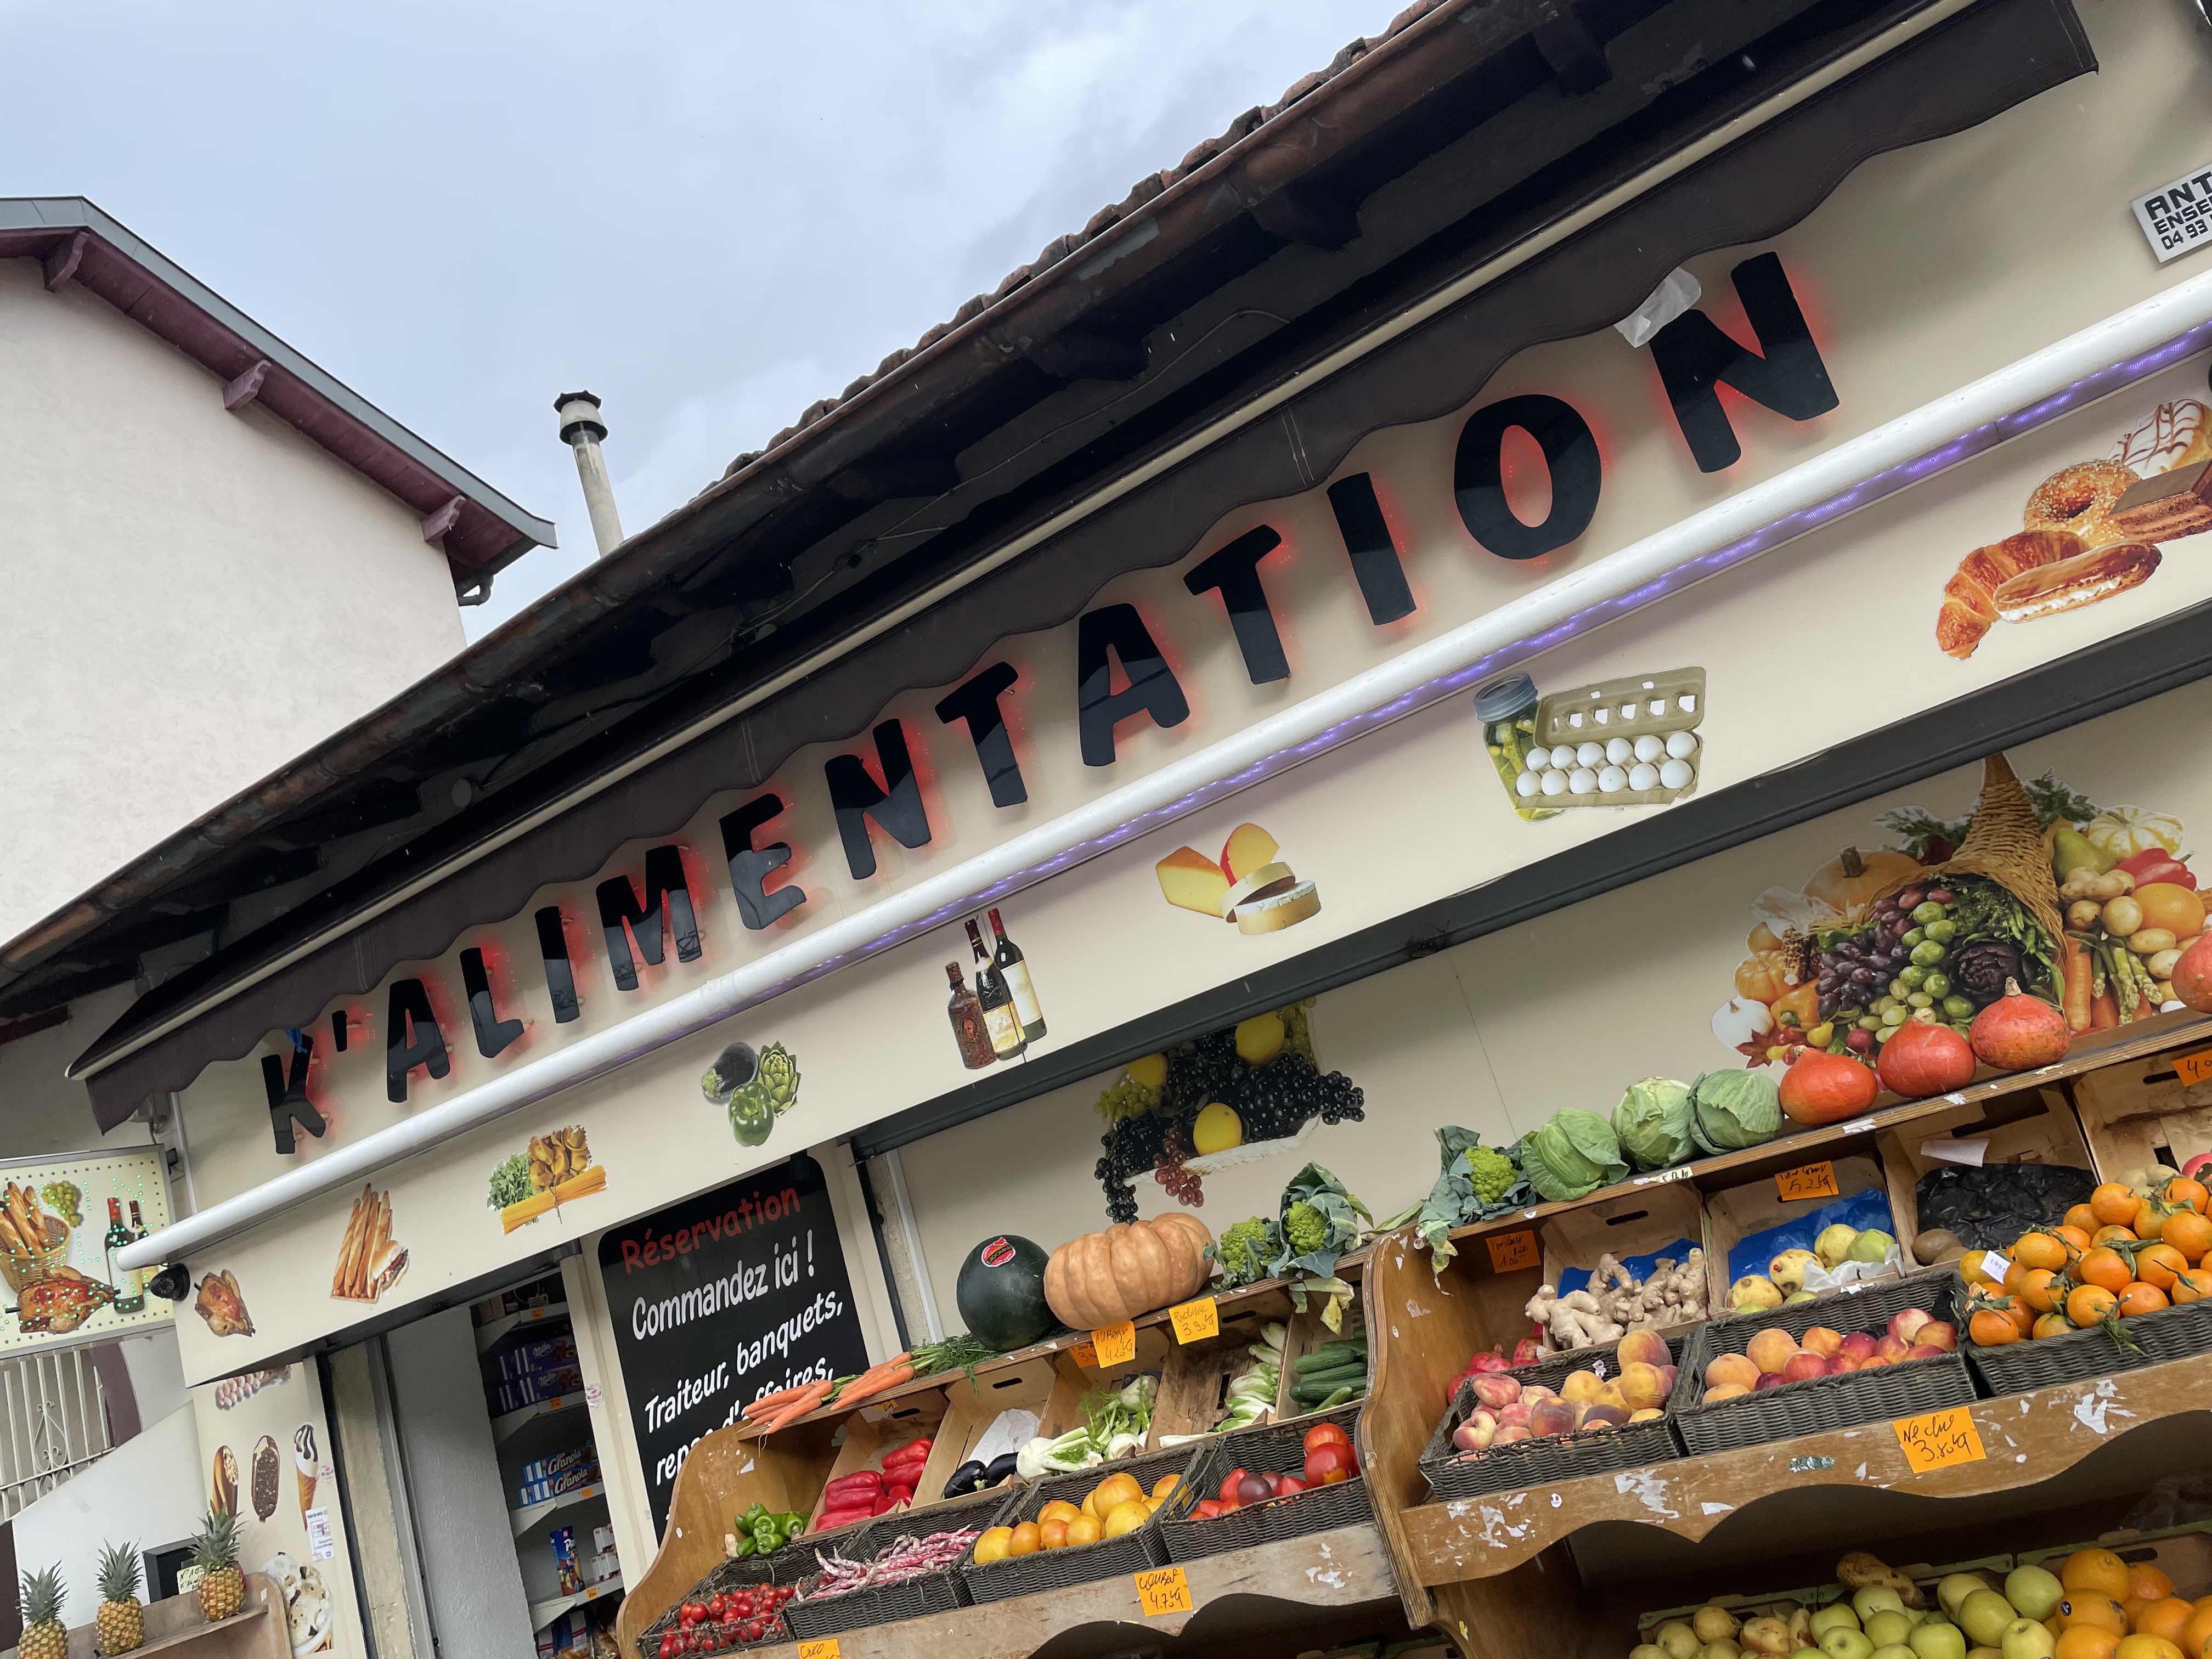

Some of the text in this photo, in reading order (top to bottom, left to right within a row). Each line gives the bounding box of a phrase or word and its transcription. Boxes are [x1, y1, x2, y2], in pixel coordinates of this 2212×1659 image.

[2153, 196, 2212, 235] ENSE
[2161, 219, 2209, 250] 04 93
[261, 252, 1840, 1154] K'ALIMENTATION
[621, 1187, 801, 1274] Réservation
[632, 1260, 769, 1340] Commandez
[774, 1235, 799, 1290] ici
[645, 1290, 843, 1433] Traiteur, banquets,
[548, 1449, 582, 1475] Granola
[554, 1468, 588, 1494] Granola
